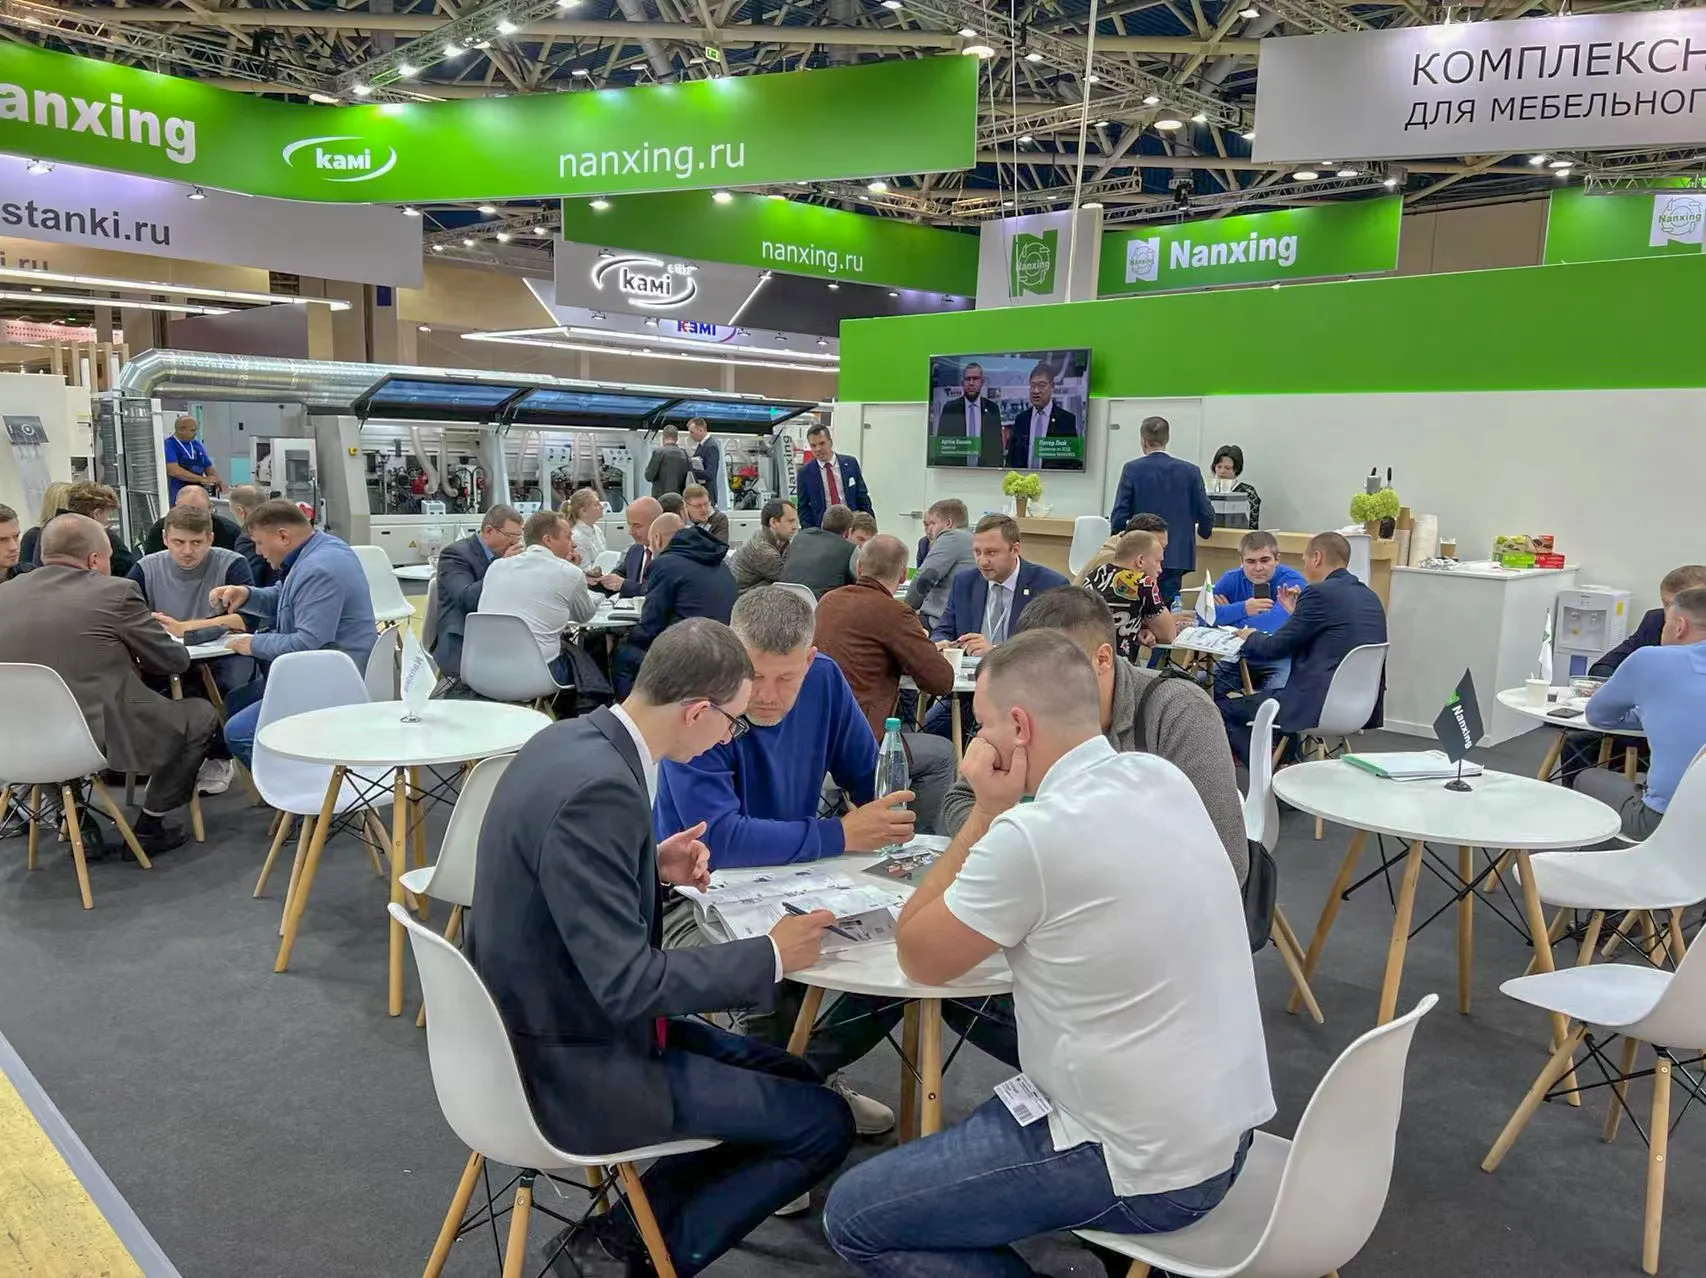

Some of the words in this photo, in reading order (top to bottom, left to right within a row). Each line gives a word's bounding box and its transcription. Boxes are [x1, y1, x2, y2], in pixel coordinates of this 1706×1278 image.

[1412, 37, 1706, 87] КОМПЛЕКСН
[0, 83, 197, 165] anxing
[1404, 99, 1476, 132] ДЛЯ
[1490, 88, 1706, 123] МЕБЕЛЬНОГ
[559, 141, 745, 179] nanxing.ru
[1, 199, 171, 246] stanki.ru
[1658, 213, 1702, 224] Nanxing
[761, 240, 864, 274] nanxing.ru
[1170, 231, 1298, 268] Nanxing
[782, 435, 798, 496] Nanxing
[1451, 703, 1473, 751] Nanxing
